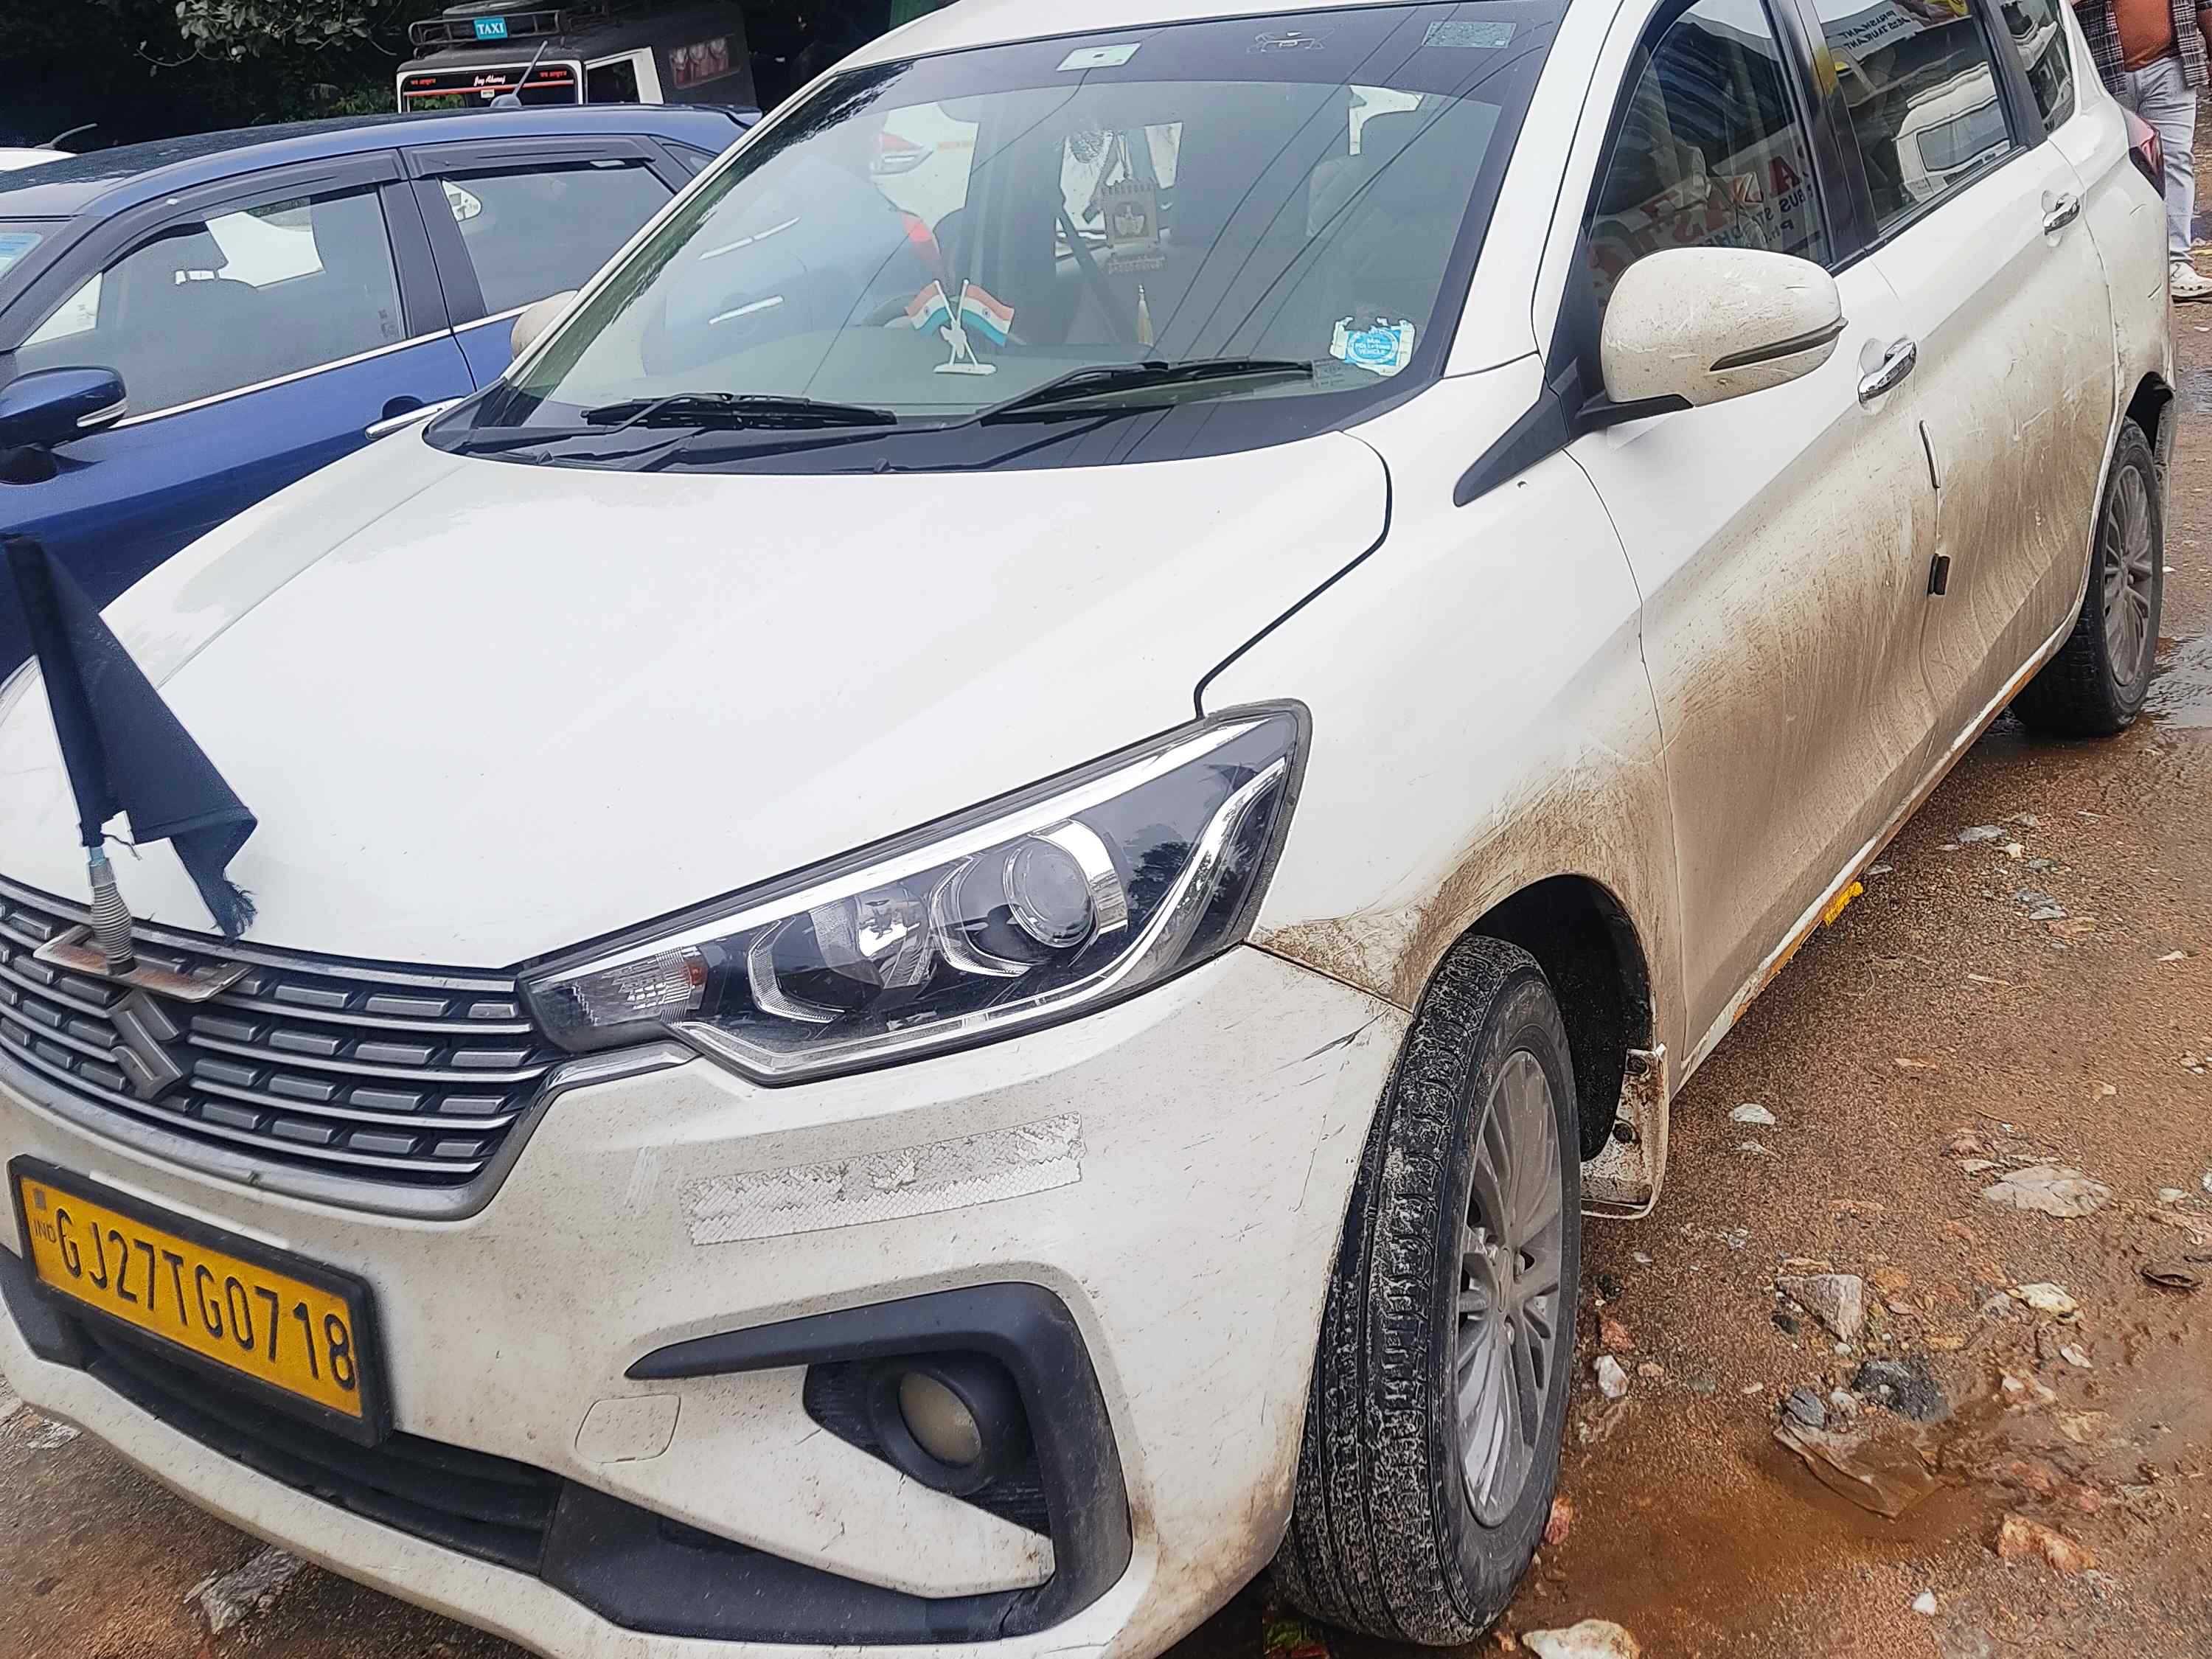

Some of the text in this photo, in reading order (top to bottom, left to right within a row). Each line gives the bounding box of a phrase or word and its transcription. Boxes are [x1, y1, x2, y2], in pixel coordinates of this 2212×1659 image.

[477, 23, 504, 35] TAXI
[32, 1219, 56, 1245] IND
[55, 1207, 355, 1391] GJ27TG0718
